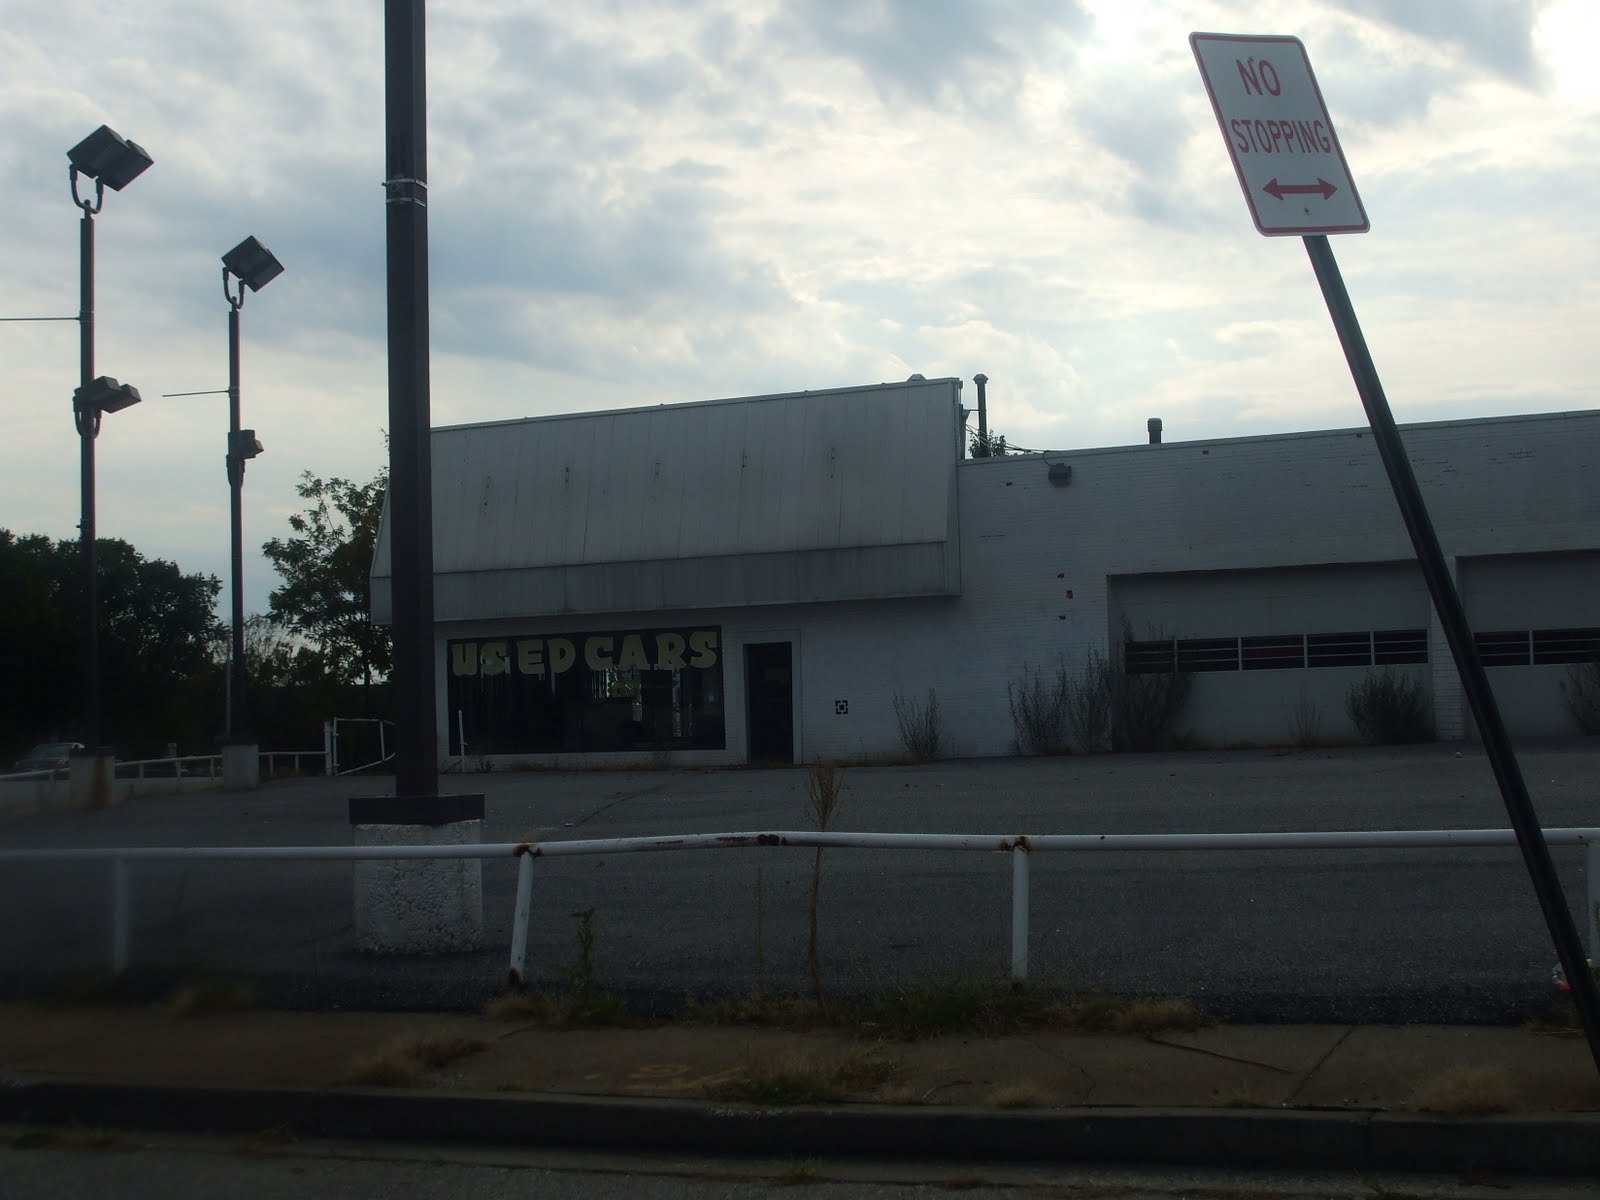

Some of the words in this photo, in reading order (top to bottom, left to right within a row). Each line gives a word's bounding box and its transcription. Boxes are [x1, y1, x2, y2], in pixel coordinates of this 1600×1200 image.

[1235, 58, 1281, 97] NO
[1230, 118, 1332, 154] STOPPING
[451, 637, 577, 677] USED
[584, 630, 718, 672] CARS
